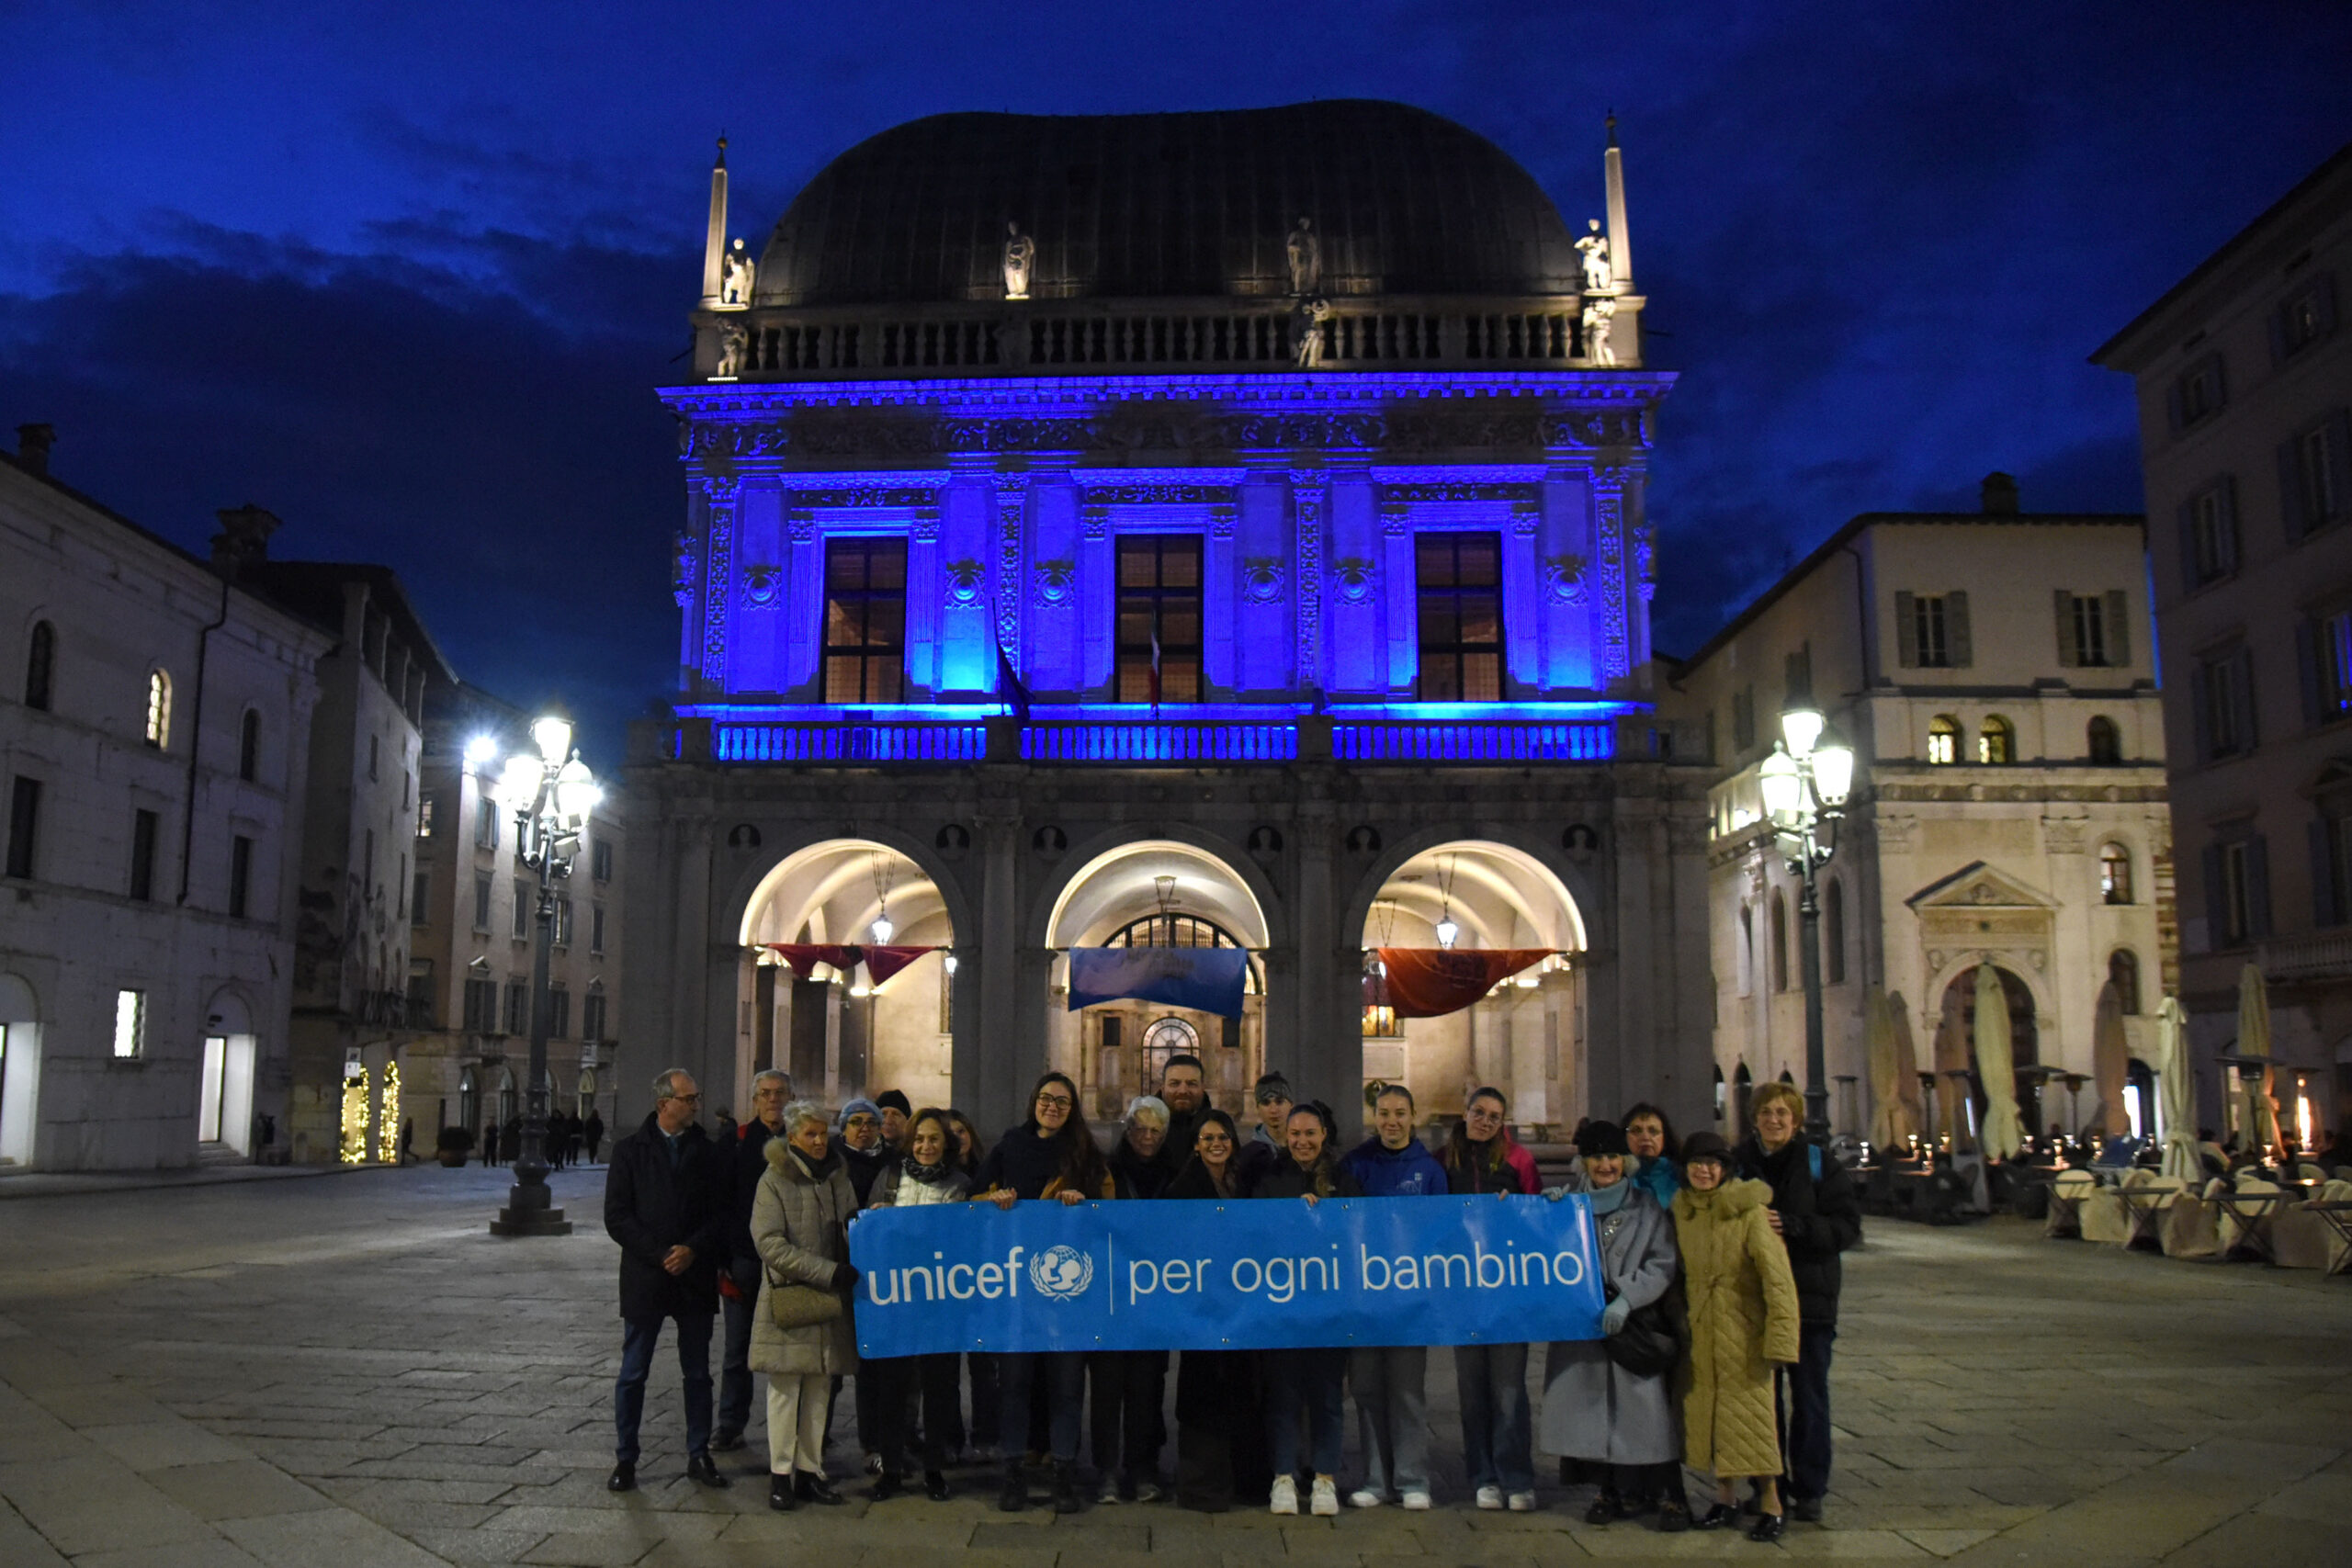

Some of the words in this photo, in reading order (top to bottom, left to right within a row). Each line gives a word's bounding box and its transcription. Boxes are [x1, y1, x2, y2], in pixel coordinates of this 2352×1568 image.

[867, 1246, 1024, 1306] unicef
[1129, 1258, 1212, 1305] per
[1230, 1243, 1340, 1303] ogni
[1361, 1240, 1584, 1291] bambino
